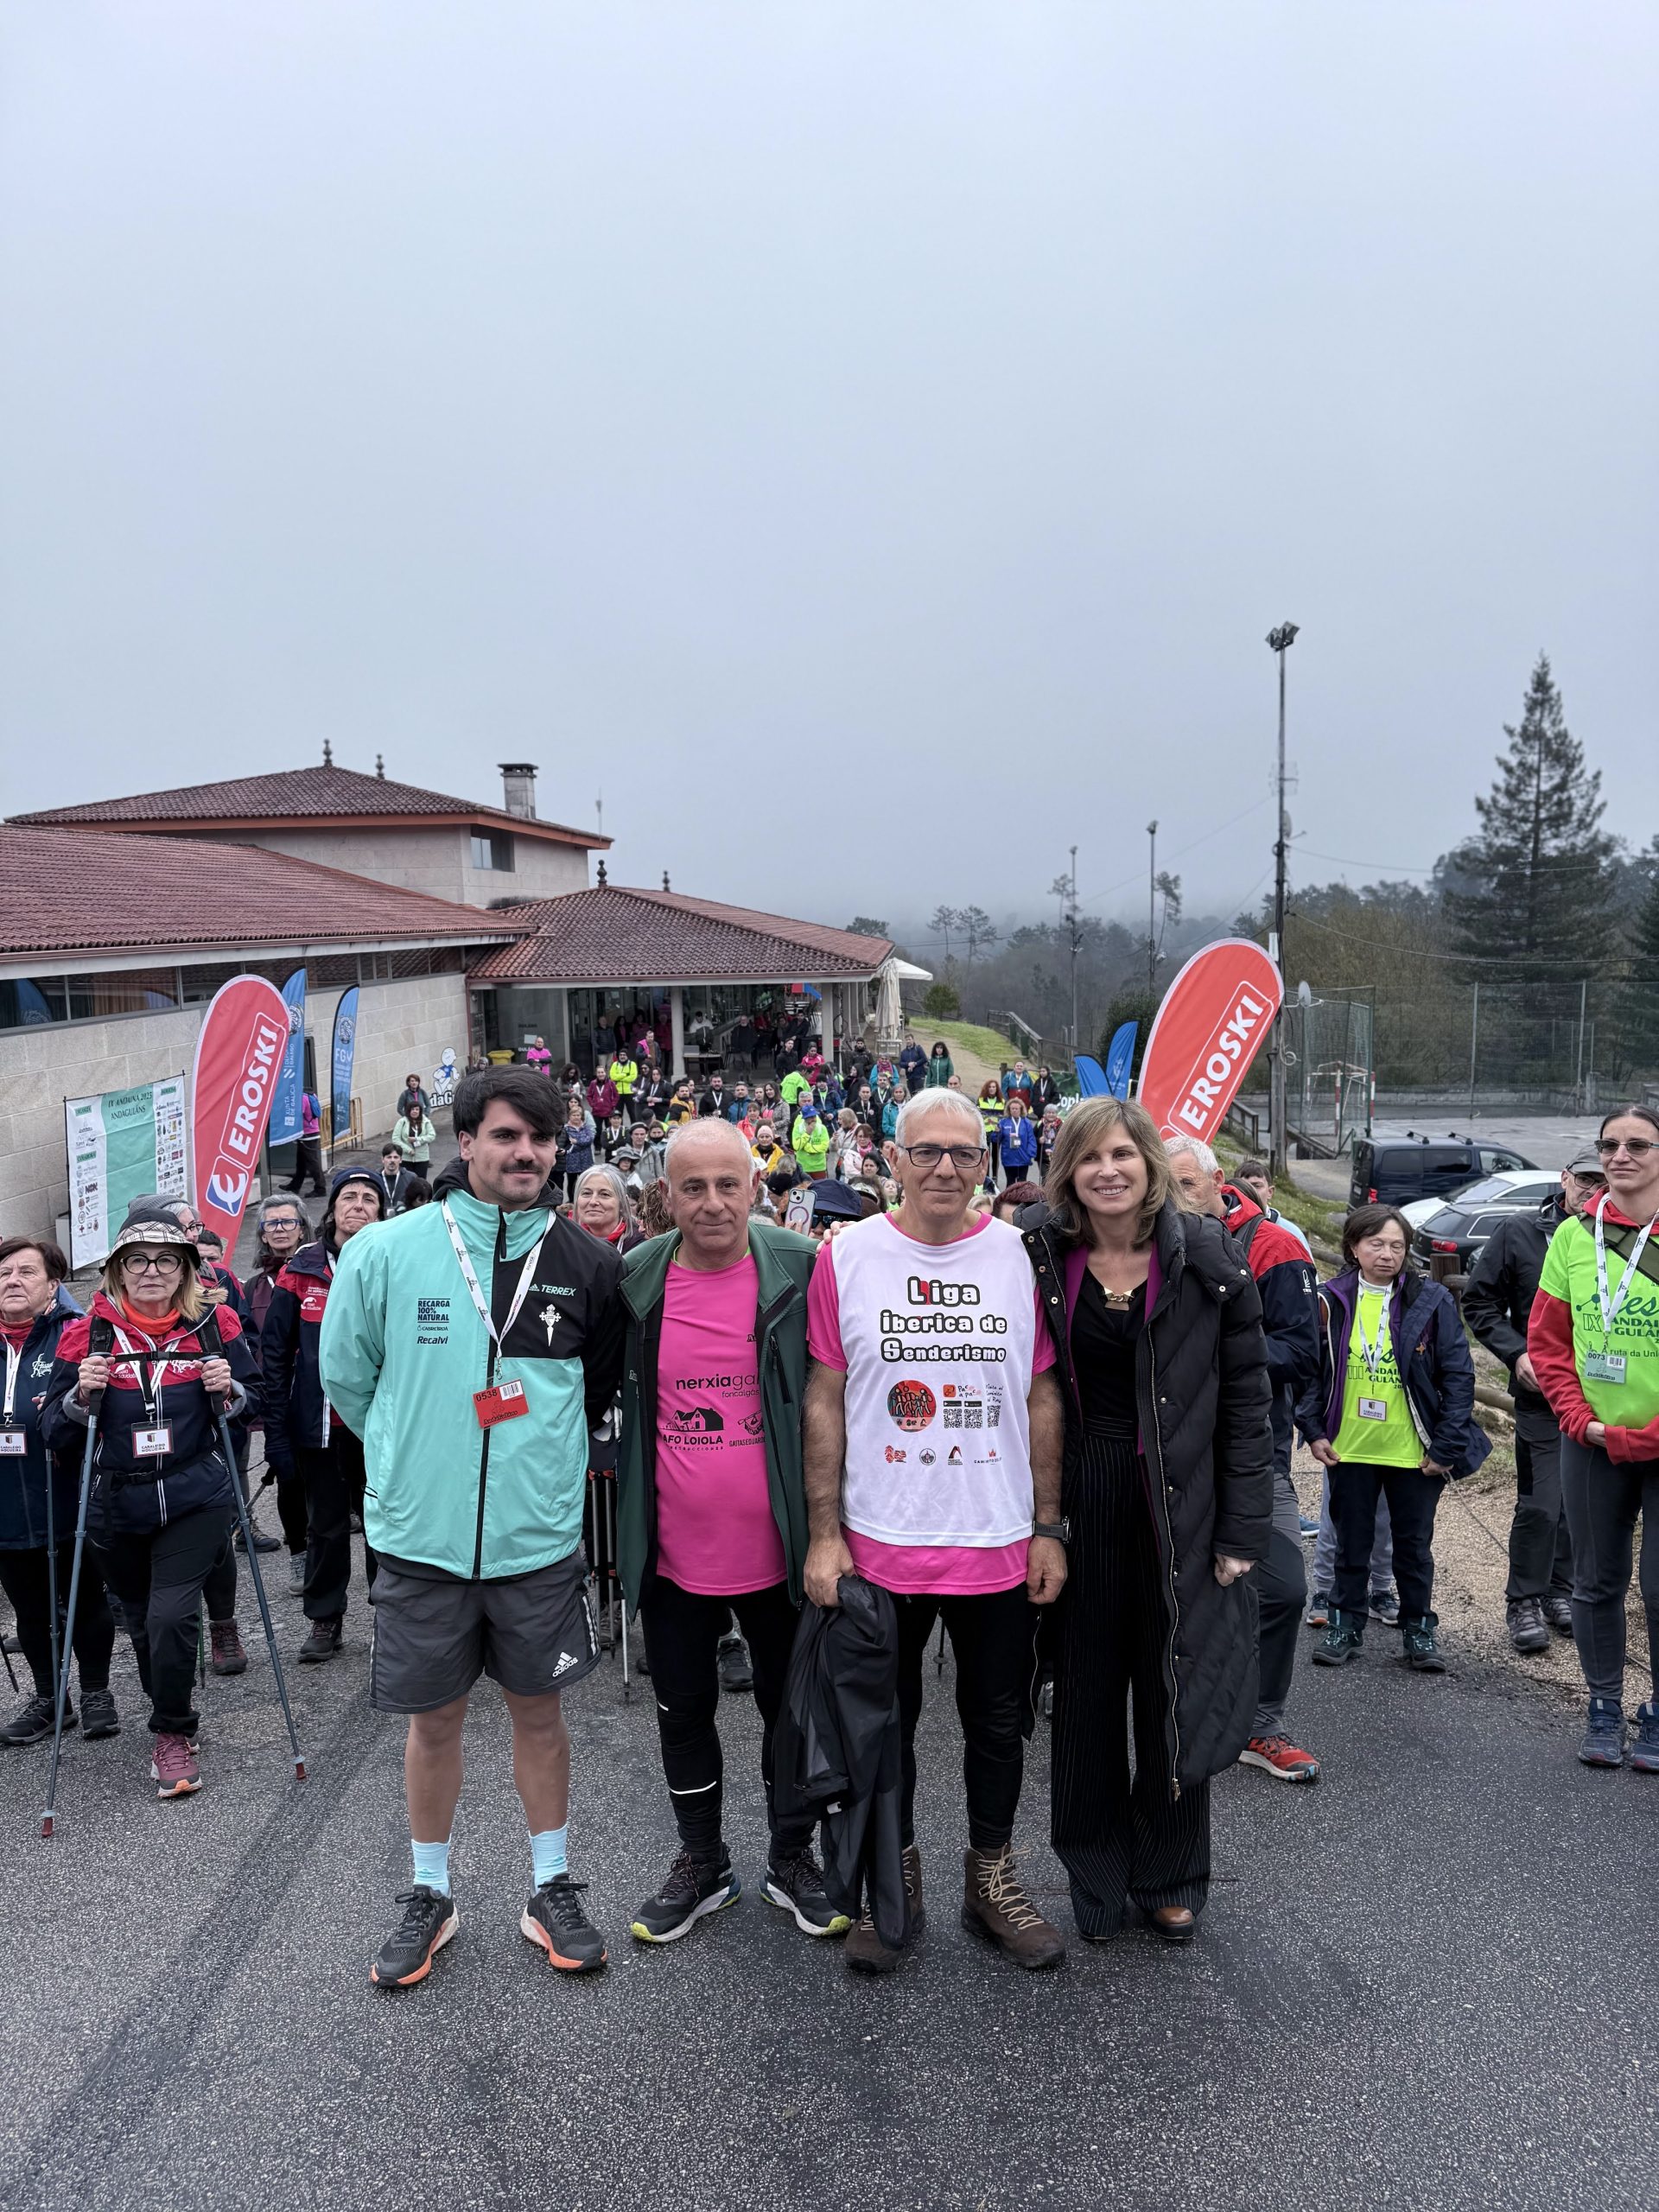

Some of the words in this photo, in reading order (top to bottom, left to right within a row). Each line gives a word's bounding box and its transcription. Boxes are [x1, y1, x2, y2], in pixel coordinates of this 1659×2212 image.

[1179, 995, 1263, 1130] EROSKI
[228, 1025, 277, 1155] EROSKI
[541, 1284, 577, 1296] TERREX
[907, 1276, 981, 1307] Liga
[980, 1314, 1007, 1334] de
[416, 1336, 448, 1344] Recalvi
[880, 1337, 1007, 1363] Senderismo
[1587, 1352, 1605, 1361] 0073
[475, 1389, 498, 1402] 0538
[683, 1435, 723, 1445] LOIOLA
[552, 1656, 578, 1677] adidas
